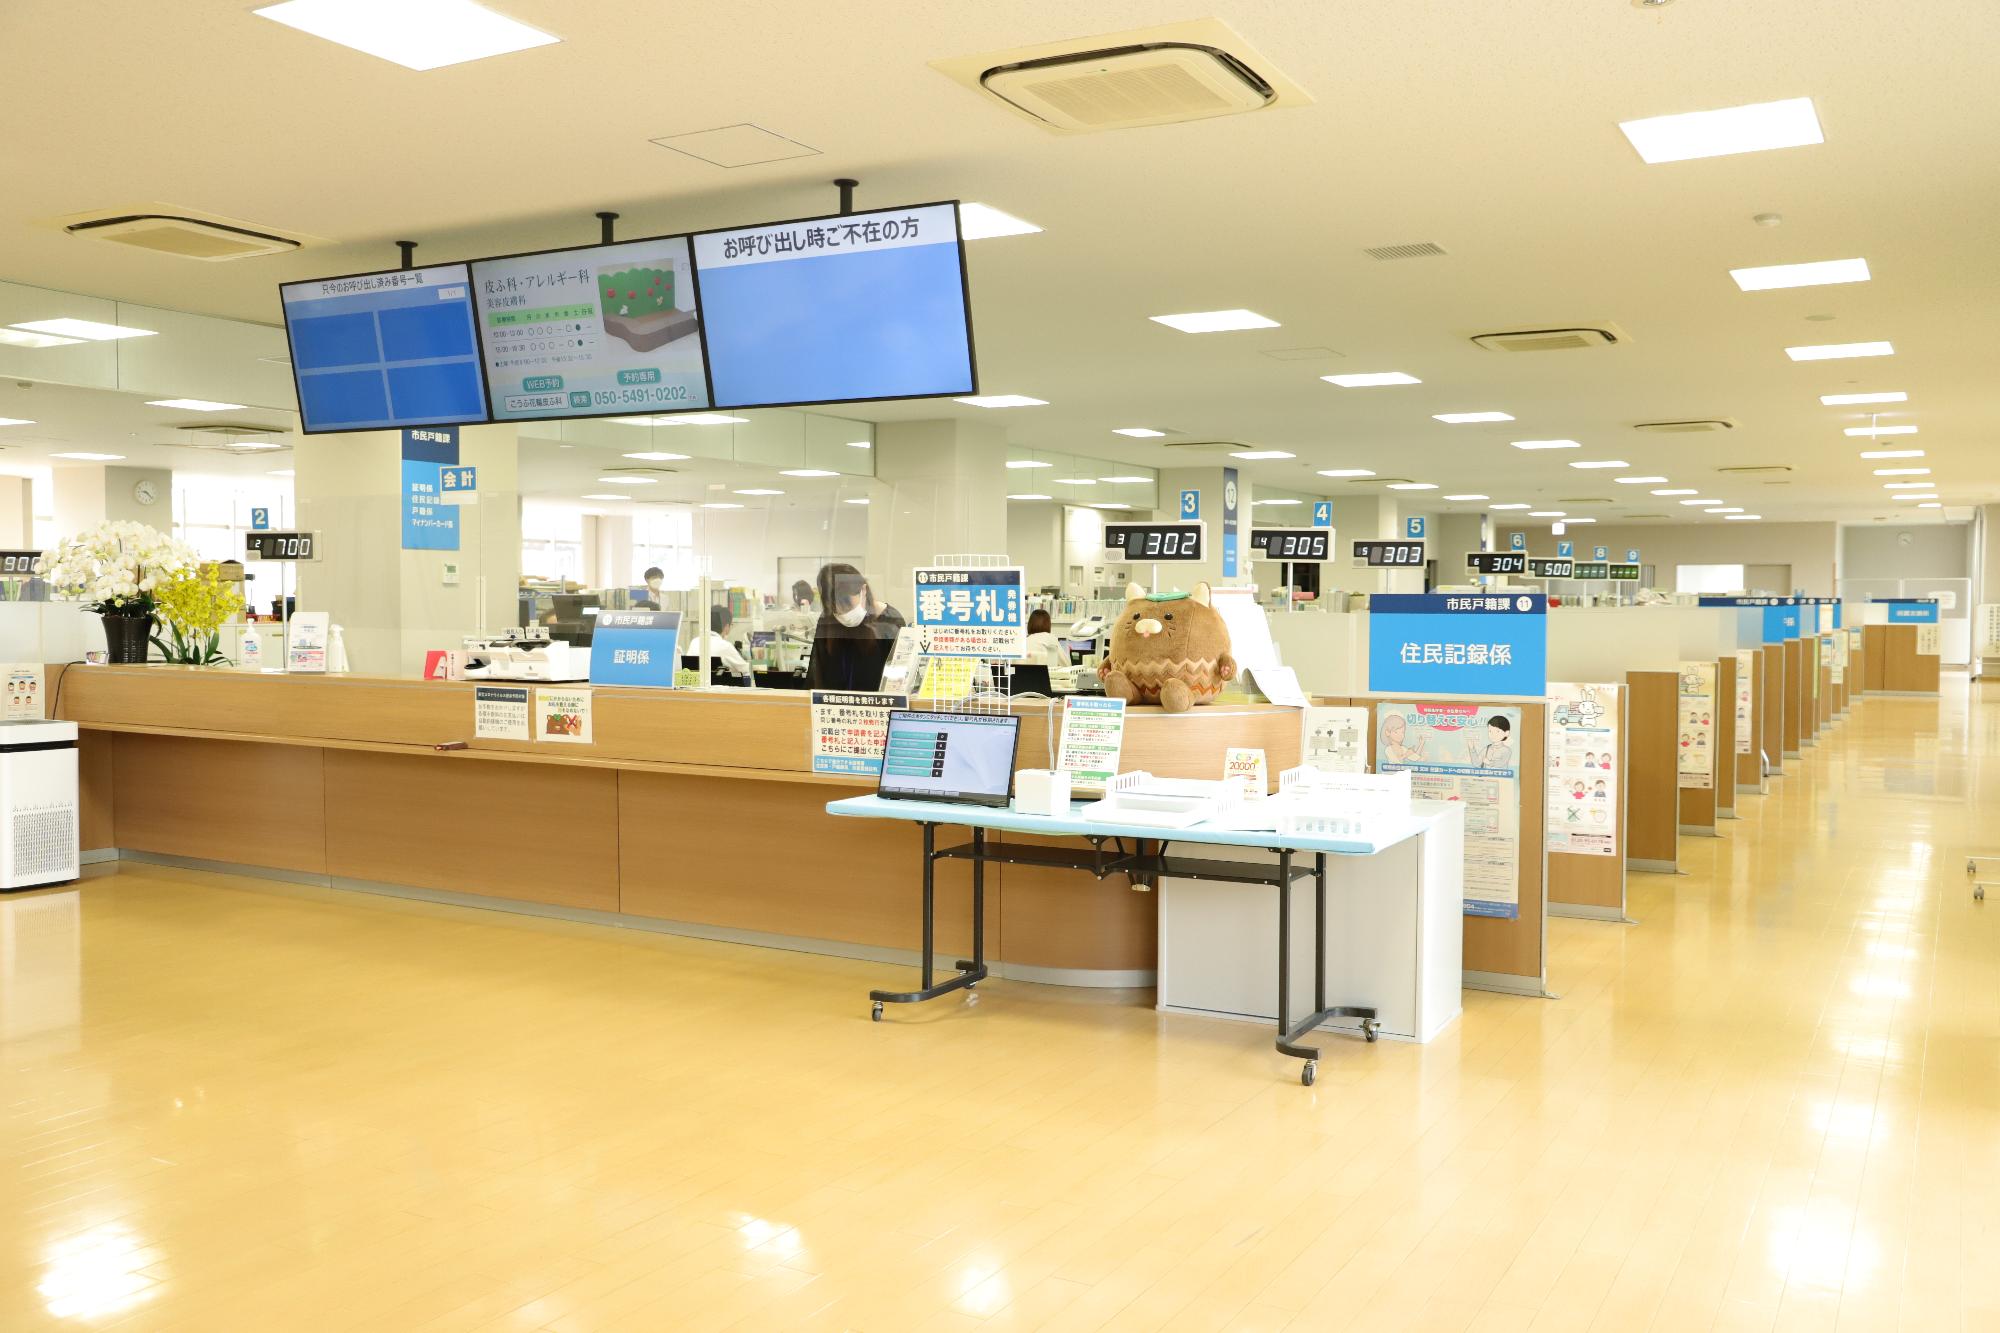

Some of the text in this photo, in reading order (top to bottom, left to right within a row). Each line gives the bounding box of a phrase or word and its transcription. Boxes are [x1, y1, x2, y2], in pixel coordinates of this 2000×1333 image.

[724, 216, 919, 258] お呼び出し時ご不在の方
[485, 269, 589, 293] 皮ふ科・アレルギー科
[595, 386, 686, 405] 050-5491-0202
[443, 471, 473, 487] 会計
[1184, 492, 1196, 515] 3
[254, 509, 266, 526] 2
[1316, 506, 1328, 521] 4
[1410, 517, 1421, 533] 5
[255, 538, 311, 556] 2 700
[1117, 533, 1197, 556] 3 302
[1260, 537, 1325, 556] 4 305
[1513, 535, 1522, 547] 6
[1561, 542, 1569, 554] 7
[1383, 546, 1422, 563] 303
[1596, 548, 1604, 559] 8
[1629, 552, 1637, 562] 9
[1491, 558, 1524, 572] 304
[1545, 563, 1571, 576] 500
[919, 589, 1005, 623] 番号札
[1007, 589, 1017, 623] 発券機
[1446, 597, 1511, 611] 市民戸籍課
[613, 649, 650, 665] 証明係
[1400, 643, 1512, 666] 住民記録係
